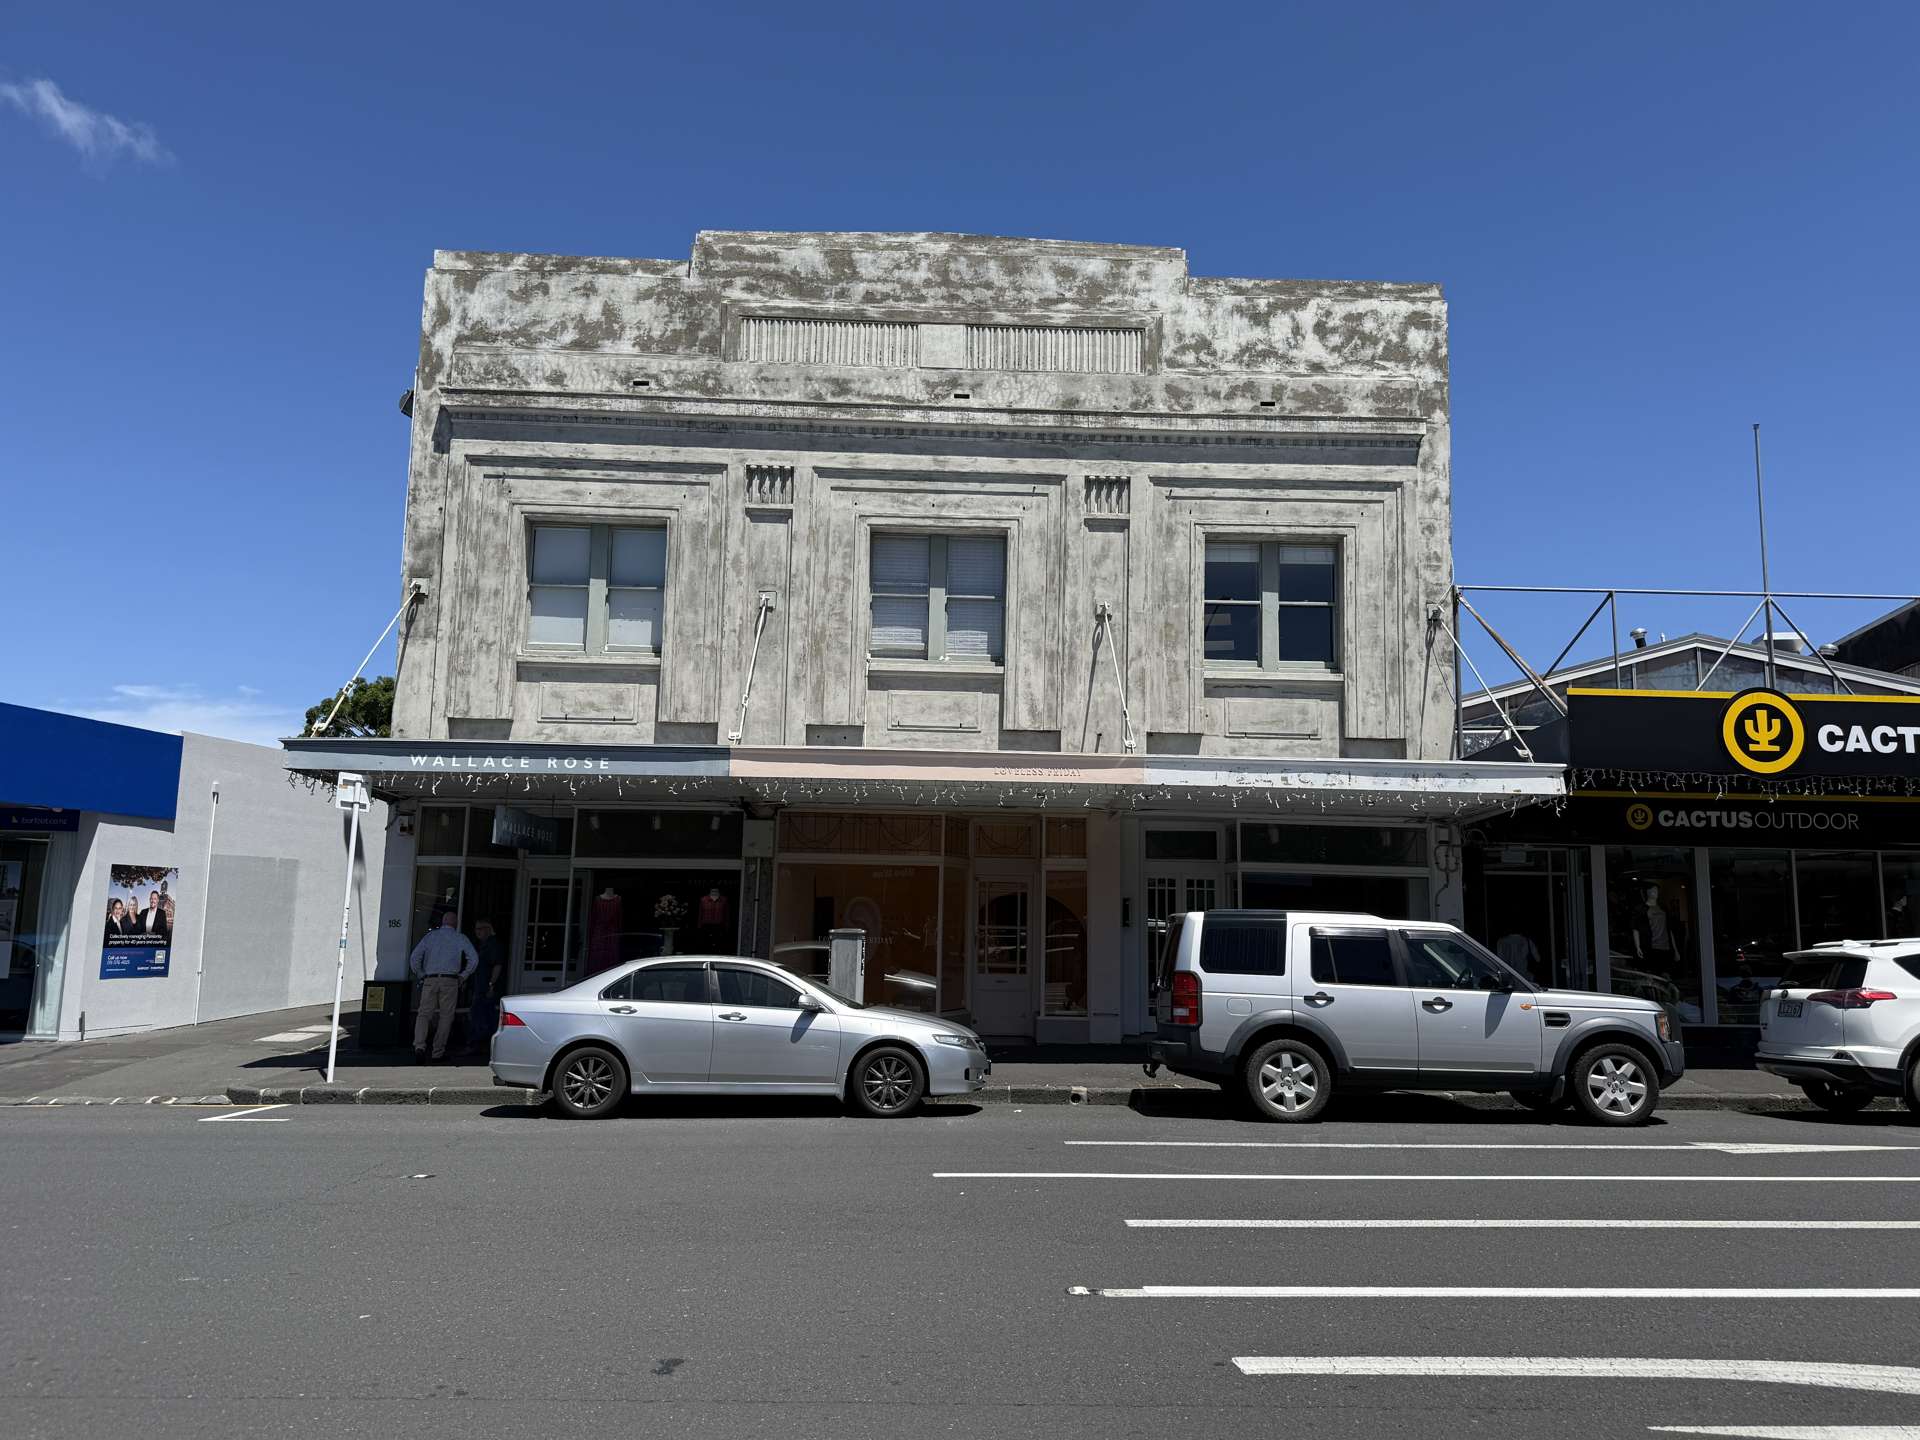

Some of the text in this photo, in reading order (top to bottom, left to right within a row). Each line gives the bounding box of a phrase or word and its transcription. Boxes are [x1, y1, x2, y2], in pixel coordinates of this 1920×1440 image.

[1817, 724, 1920, 754] CACT
[411, 755, 609, 769] WALLACE ROSE
[993, 767, 1082, 777] LOVELESS FRIDAY
[388, 919, 402, 928] 186
